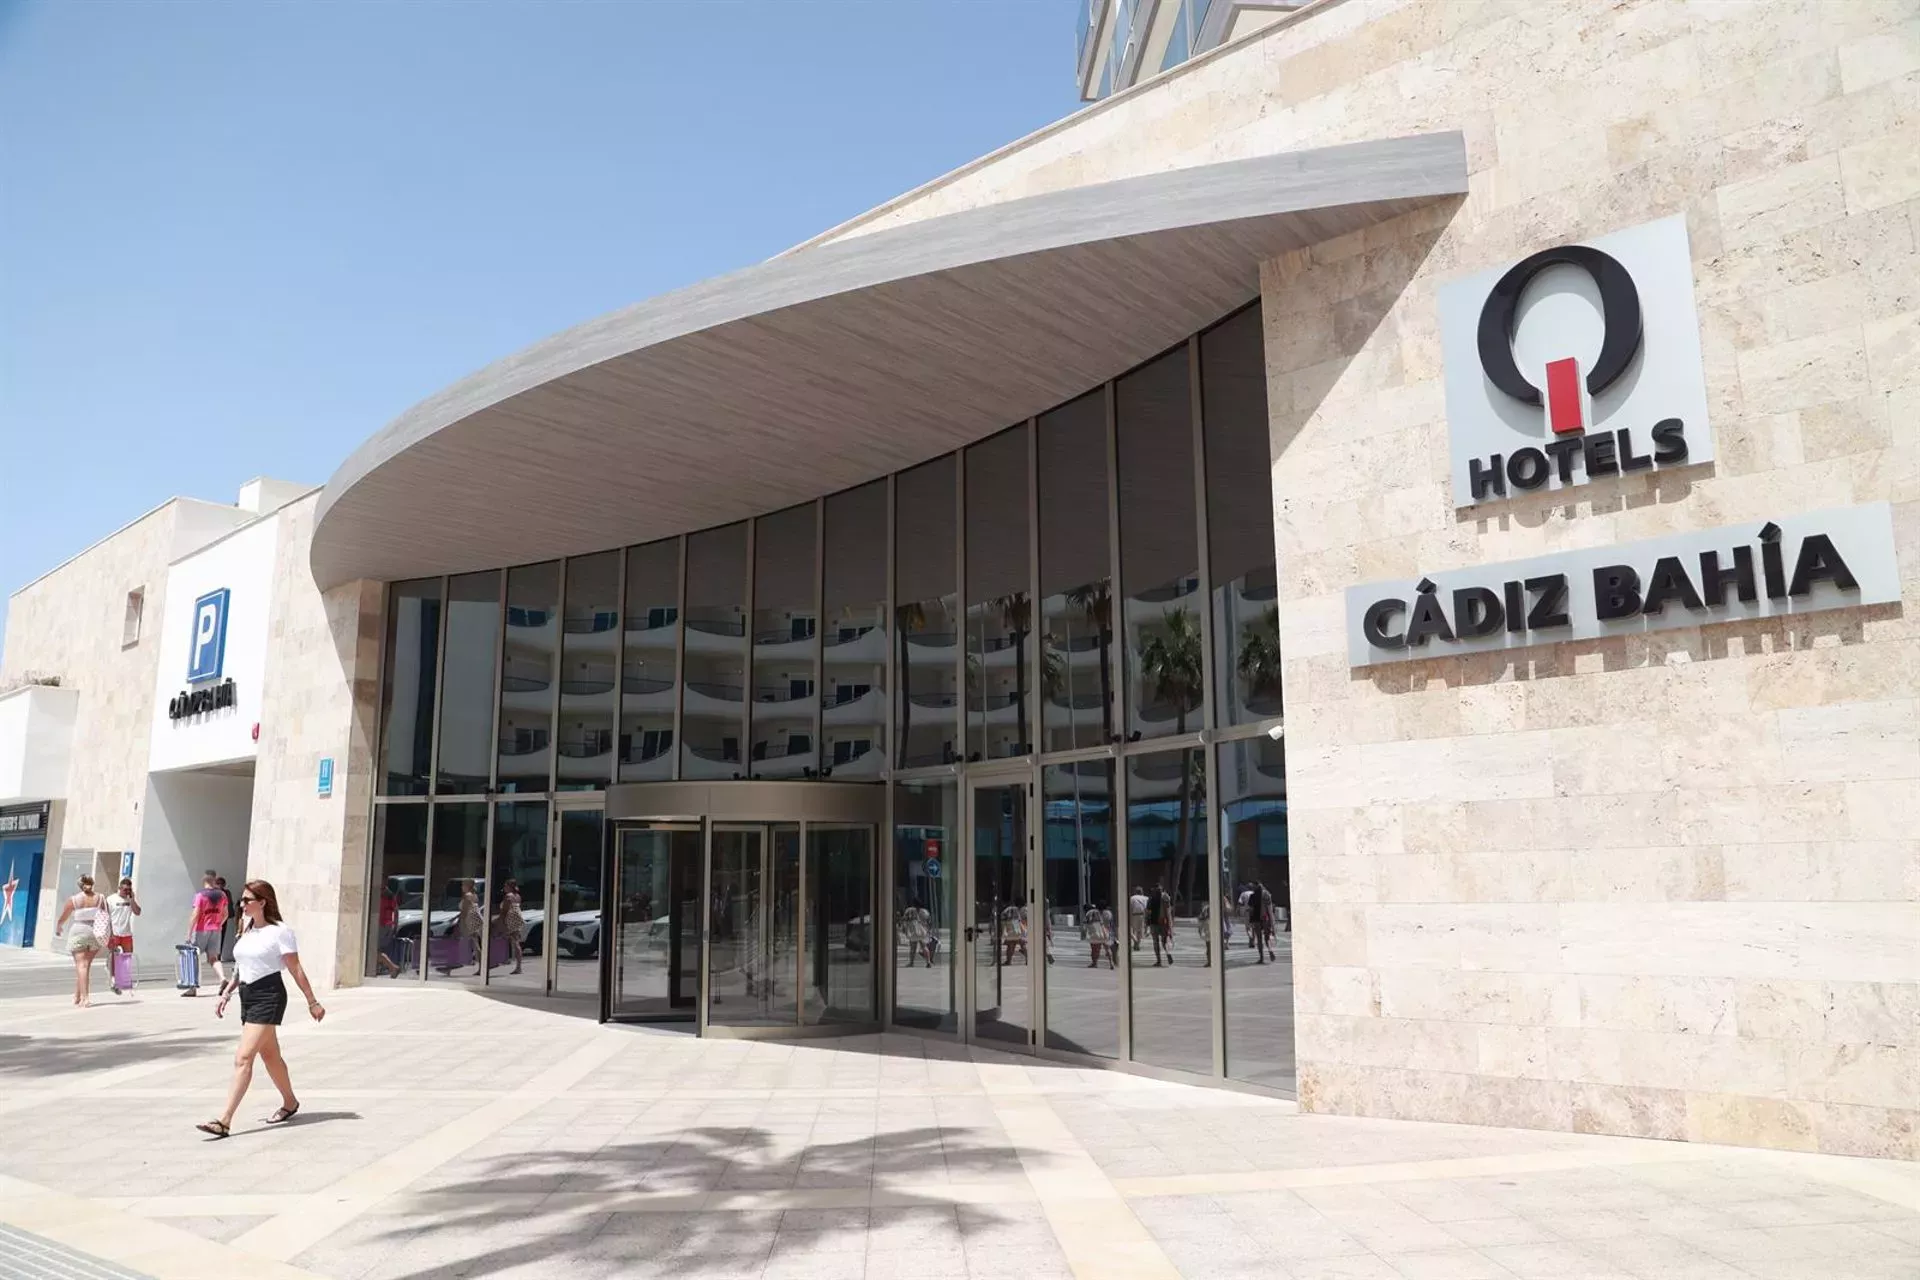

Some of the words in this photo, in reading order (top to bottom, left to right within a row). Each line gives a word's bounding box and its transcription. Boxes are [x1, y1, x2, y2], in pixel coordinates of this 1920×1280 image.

[1469, 418, 1690, 500] HOTELS
[1363, 577, 1572, 650] CÁDIZ
[1592, 521, 1861, 620] BAHÍA
[194, 603, 217, 672] P
